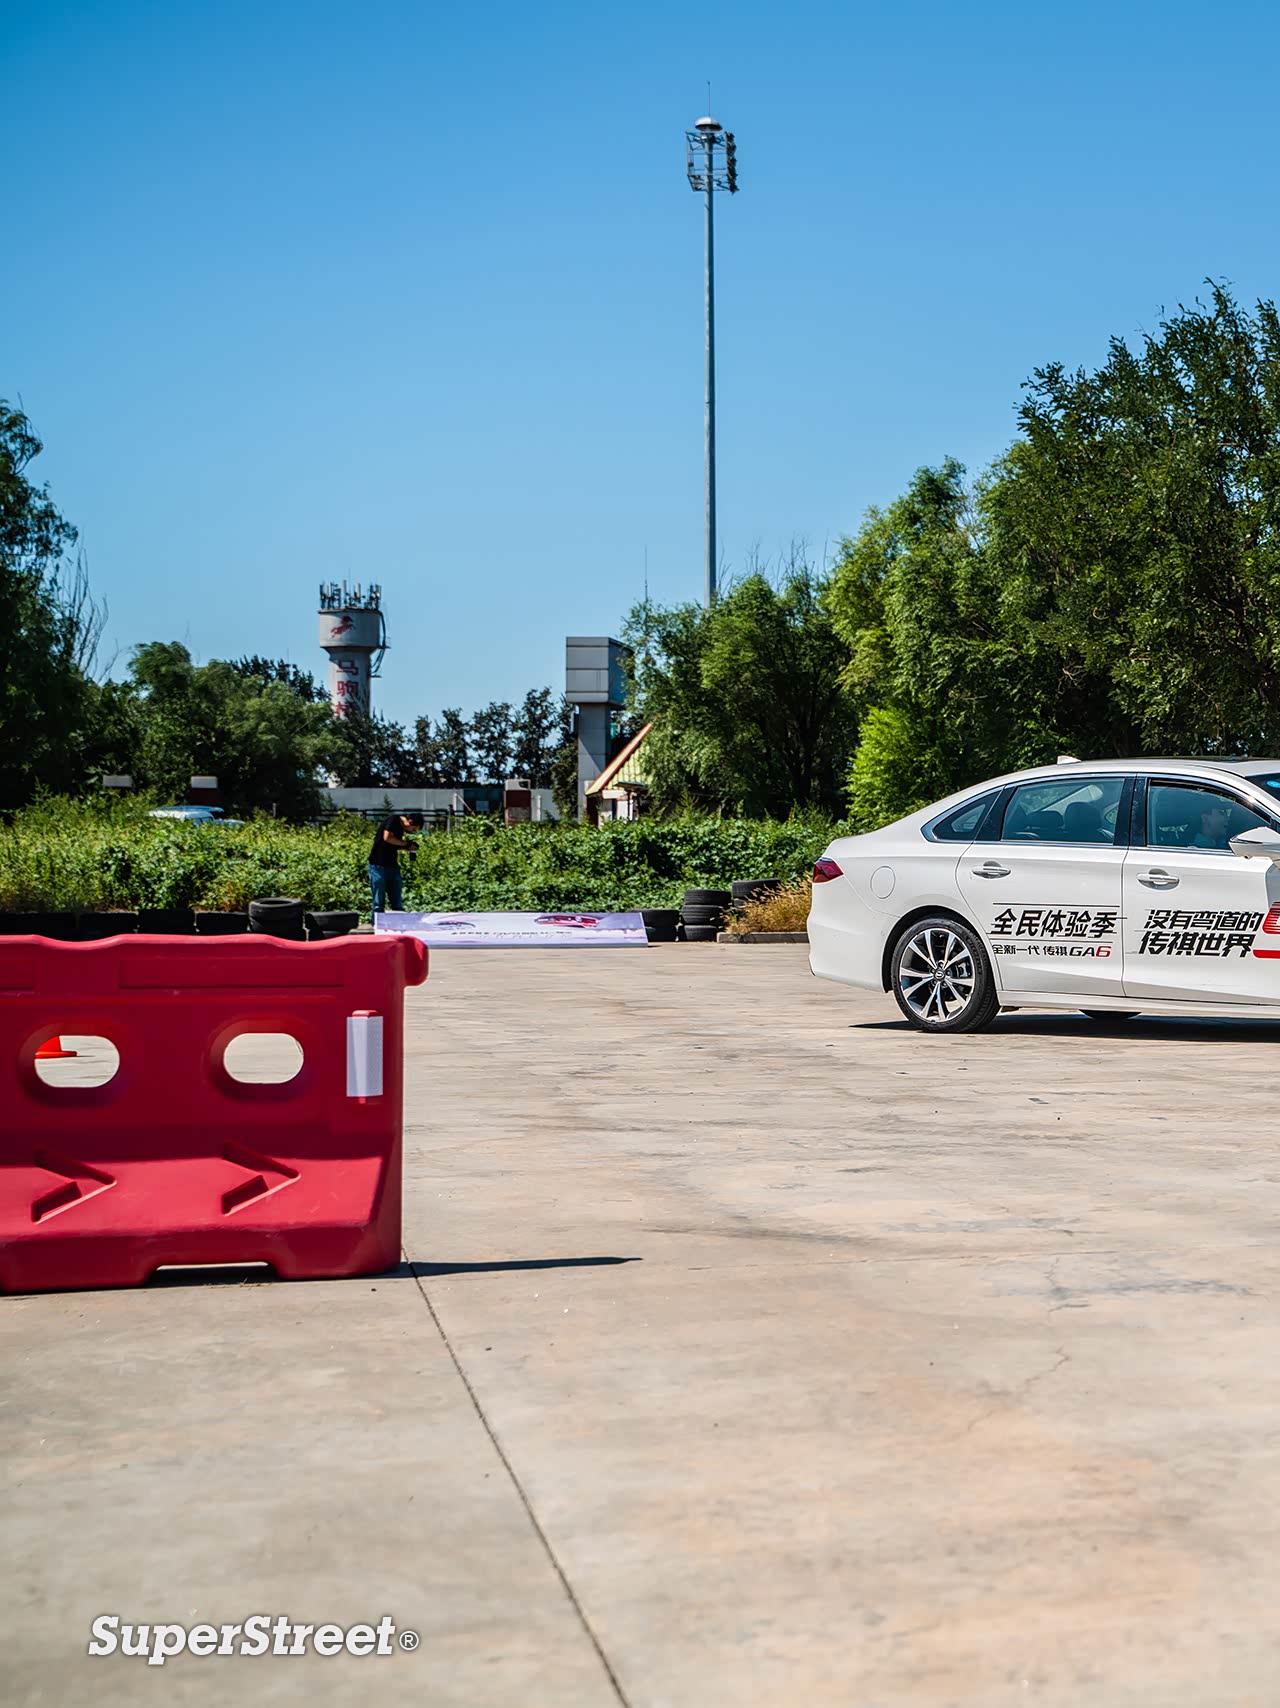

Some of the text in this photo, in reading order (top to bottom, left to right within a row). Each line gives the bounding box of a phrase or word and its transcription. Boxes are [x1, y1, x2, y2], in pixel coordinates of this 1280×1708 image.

[990, 908, 1118, 938] 全民体验季
[1144, 909, 1265, 932] 没有弯道的
[992, 944, 1040, 955] 全新一代
[1138, 931, 1256, 958] 传祺世界
